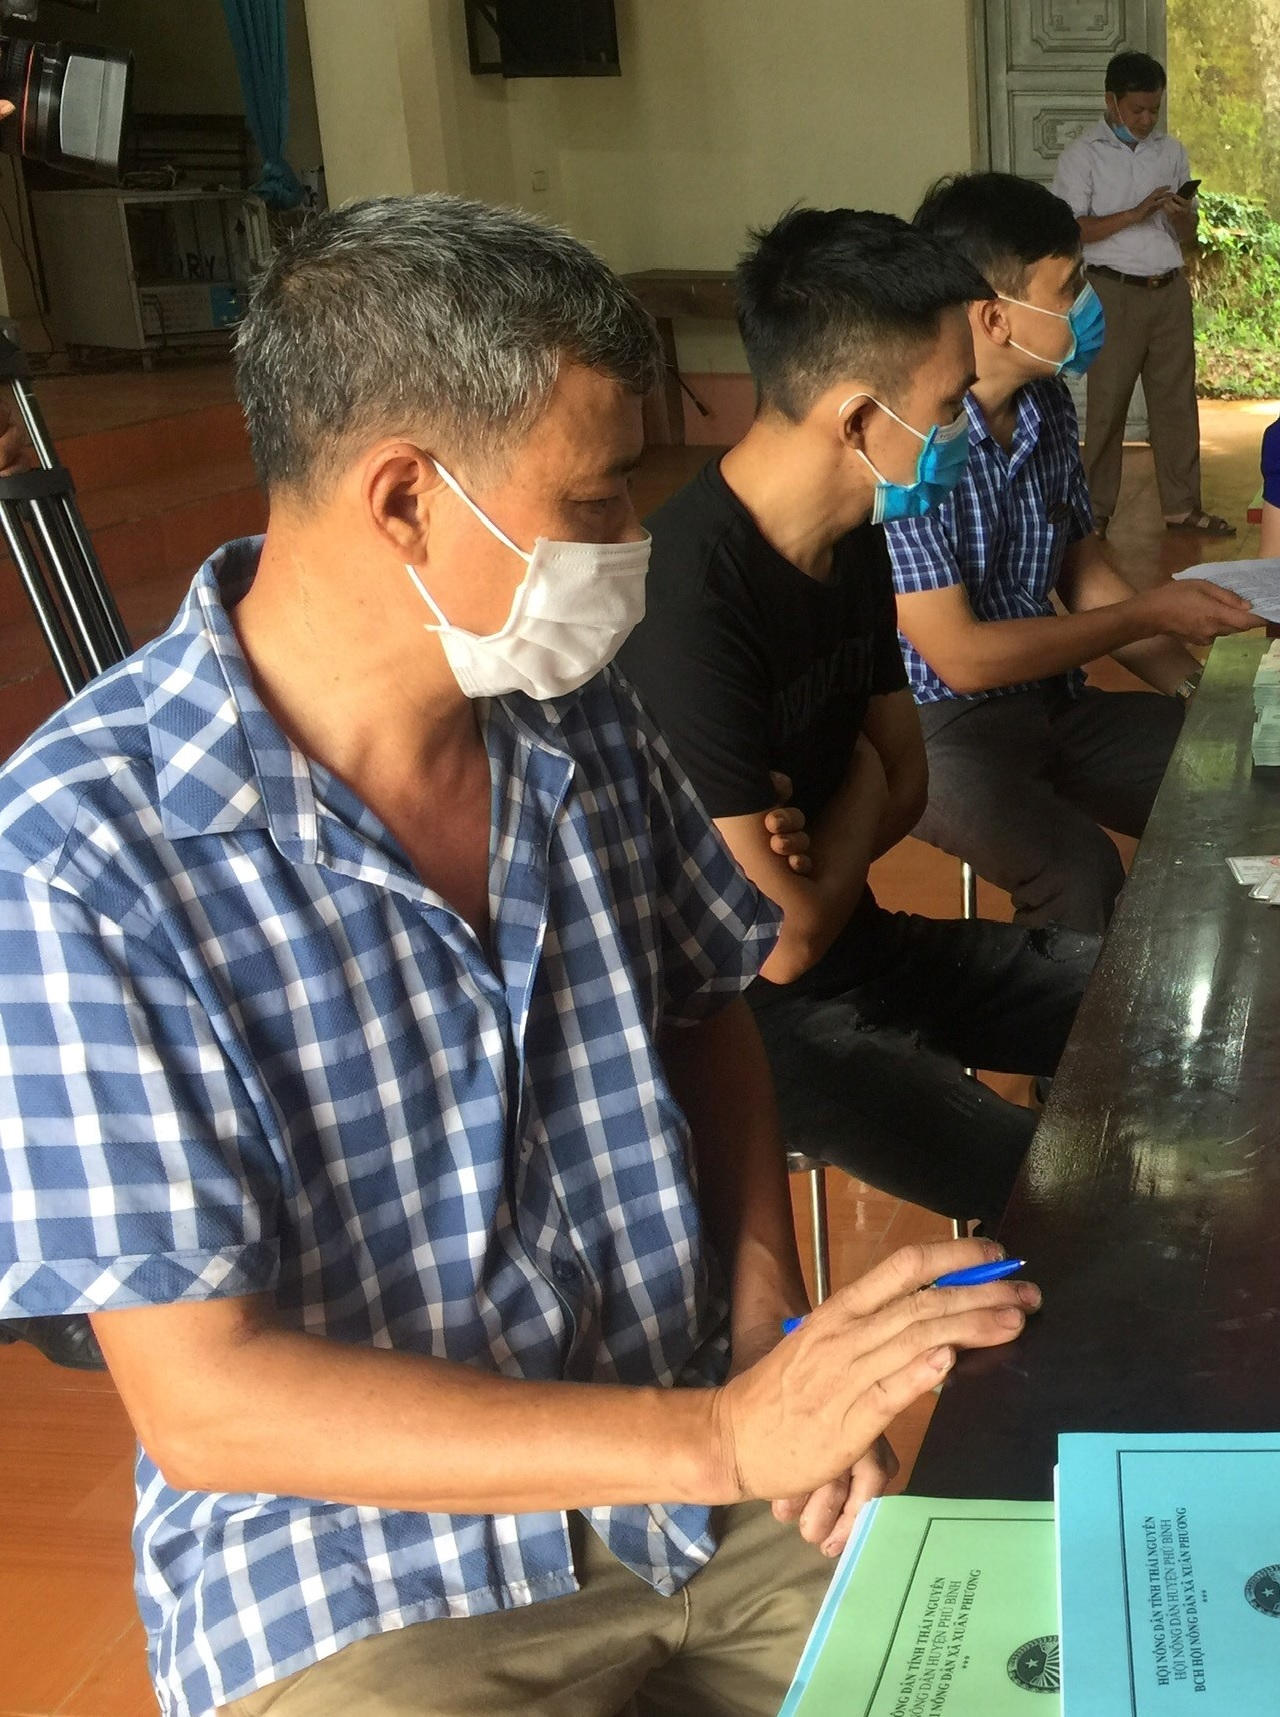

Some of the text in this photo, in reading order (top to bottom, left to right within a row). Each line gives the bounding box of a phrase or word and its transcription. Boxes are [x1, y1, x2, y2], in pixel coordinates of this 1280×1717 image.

[944, 1581, 961, 1604] BÌNH
[960, 1570, 981, 1610] PHƯƠNG
[1142, 1517, 1171, 1685] HỘI NÔNG DÂN TỈNH THÁI NGUYÊN
[1160, 1520, 1188, 1680] HỘI NÔNG DÂN HUYỆN PHÚ BÌNH
[1176, 1508, 1206, 1692] BCH HỘI NÔNG DÂN XÃ XUÂN PHƯƠNG
[937, 1607, 954, 1628] PHÚ
[952, 1613, 968, 1641] XUÂN
[890, 1577, 945, 1717] ÔNG DÂN TỈNH THÁI NGUYÊN
[926, 1631, 947, 1666] HUYỆN
[947, 1644, 961, 1657] XÃ
[919, 1668, 936, 1690] DÂN
[940, 1660, 955, 1681] DÂN
[930, 1683, 950, 1711] NÔNG
